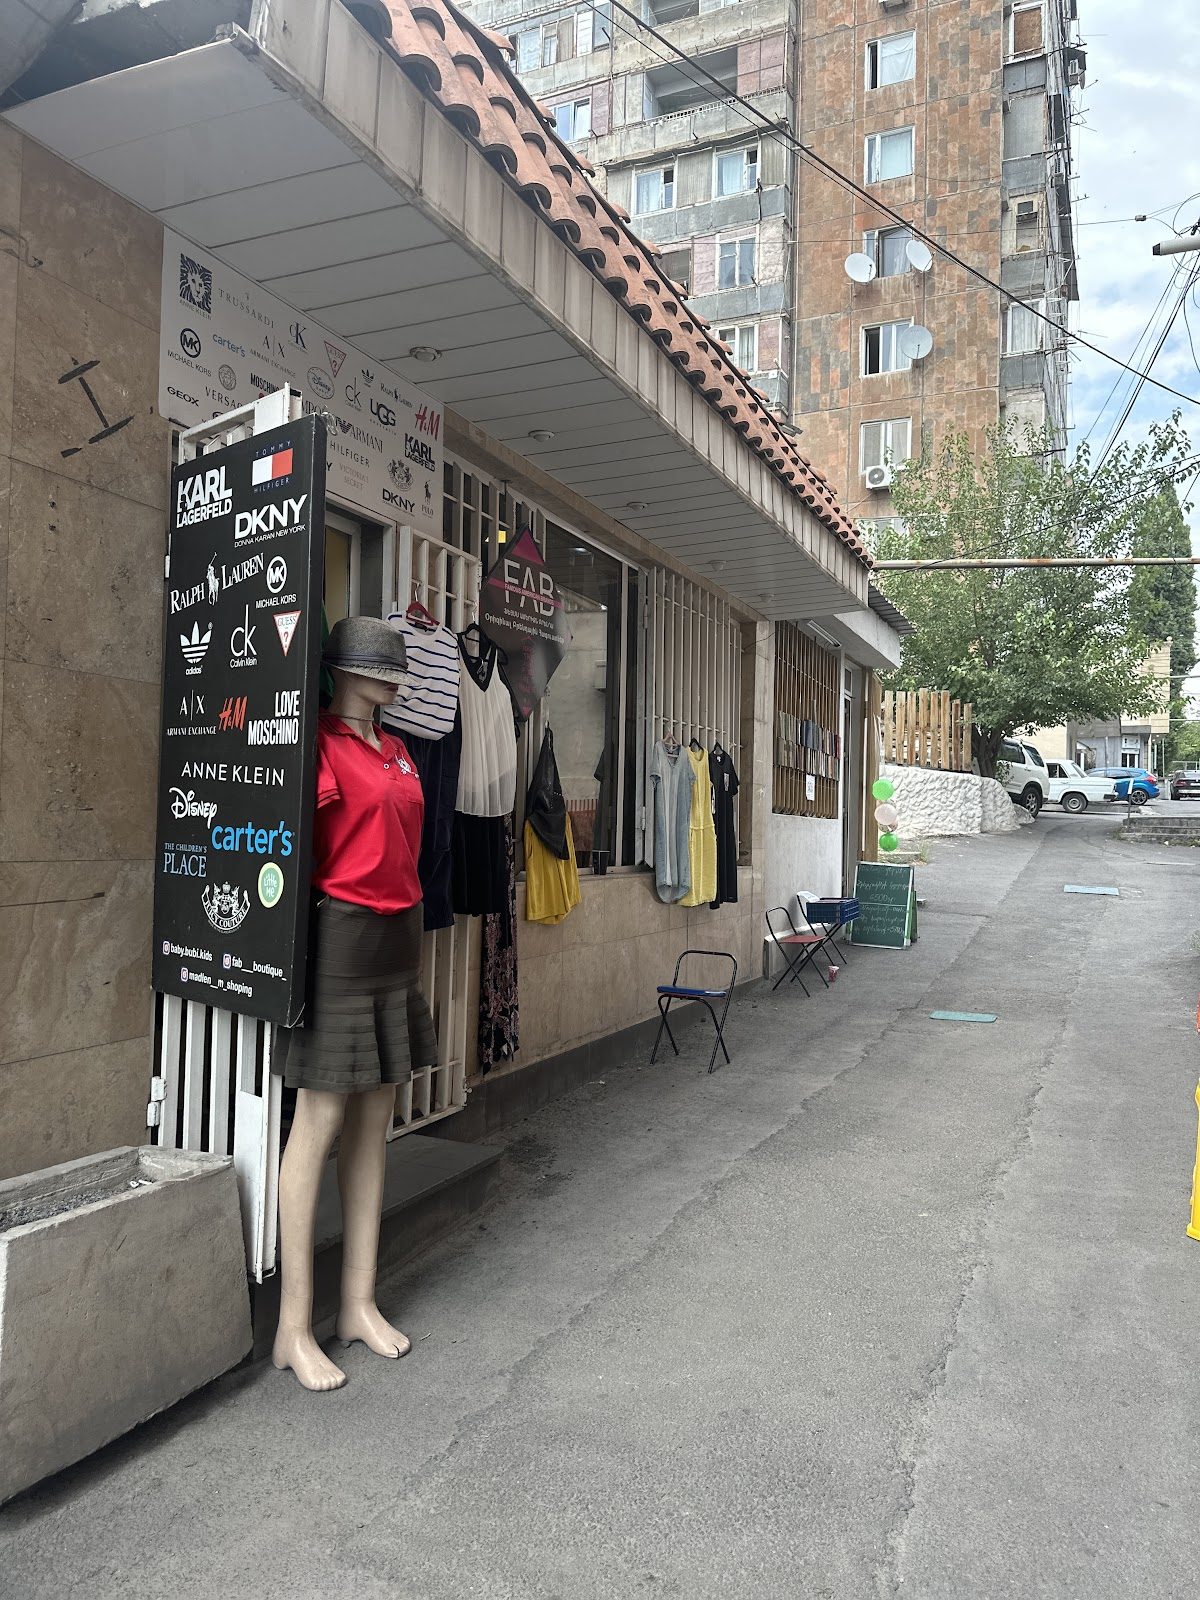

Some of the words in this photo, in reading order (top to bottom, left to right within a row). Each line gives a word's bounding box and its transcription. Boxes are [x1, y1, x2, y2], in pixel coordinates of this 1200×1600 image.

[196, 308, 212, 321] KLEIN
[218, 291, 274, 329] TRUSSARDI
[212, 333, 247, 358] carter's
[167, 349, 195, 369] MICHAEL
[195, 363, 212, 378] KORS
[167, 386, 200, 408] GEOX
[370, 398, 396, 427] UGG
[255, 440, 291, 458] TOMMY
[350, 425, 383, 453] ARMANI
[404, 433, 435, 467] KARL
[330, 441, 370, 468] HILFIGER
[404, 449, 436, 473] LAGERFELD
[177, 465, 233, 513] KARL
[253, 477, 290, 494] HILFIGER
[382, 488, 415, 512] DKNY
[176, 498, 233, 529] LAGERFELD
[234, 494, 308, 540] DKNY
[234, 535, 254, 548] DONNA
[254, 532, 275, 544] KARAN
[275, 529, 289, 538] NEW
[288, 524, 306, 534] YORK
[170, 582, 205, 615] RALPH
[221, 552, 265, 590] LAUREN
[504, 558, 554, 617] FAB
[504, 583, 522, 594] FAMOUS
[521, 588, 540, 600] AMERICAN
[540, 595, 555, 606] BRANDS
[255, 597, 280, 609] MICHAEL
[280, 593, 297, 605] KORS
[277, 615, 296, 627] GUESS
[185, 665, 202, 676] adidas
[230, 658, 244, 669] Calvin
[244, 657, 258, 667] Klein
[218, 695, 248, 732] H&M
[274, 690, 300, 717] LOVE
[167, 726, 187, 737] ARMANI
[188, 725, 217, 736] EXCHANGE
[247, 718, 299, 746] MOSCHINO
[181, 761, 228, 781] ANNE
[232, 764, 285, 787] KLEIN
[164, 842, 175, 851] THE
[175, 843, 208, 854] CHILDREN'S
[211, 820, 293, 857] carter's
[163, 852, 207, 878] PLACE
[218, 906, 248, 929] COUTURE
[170, 943, 213, 961] baby.bubi.kids
